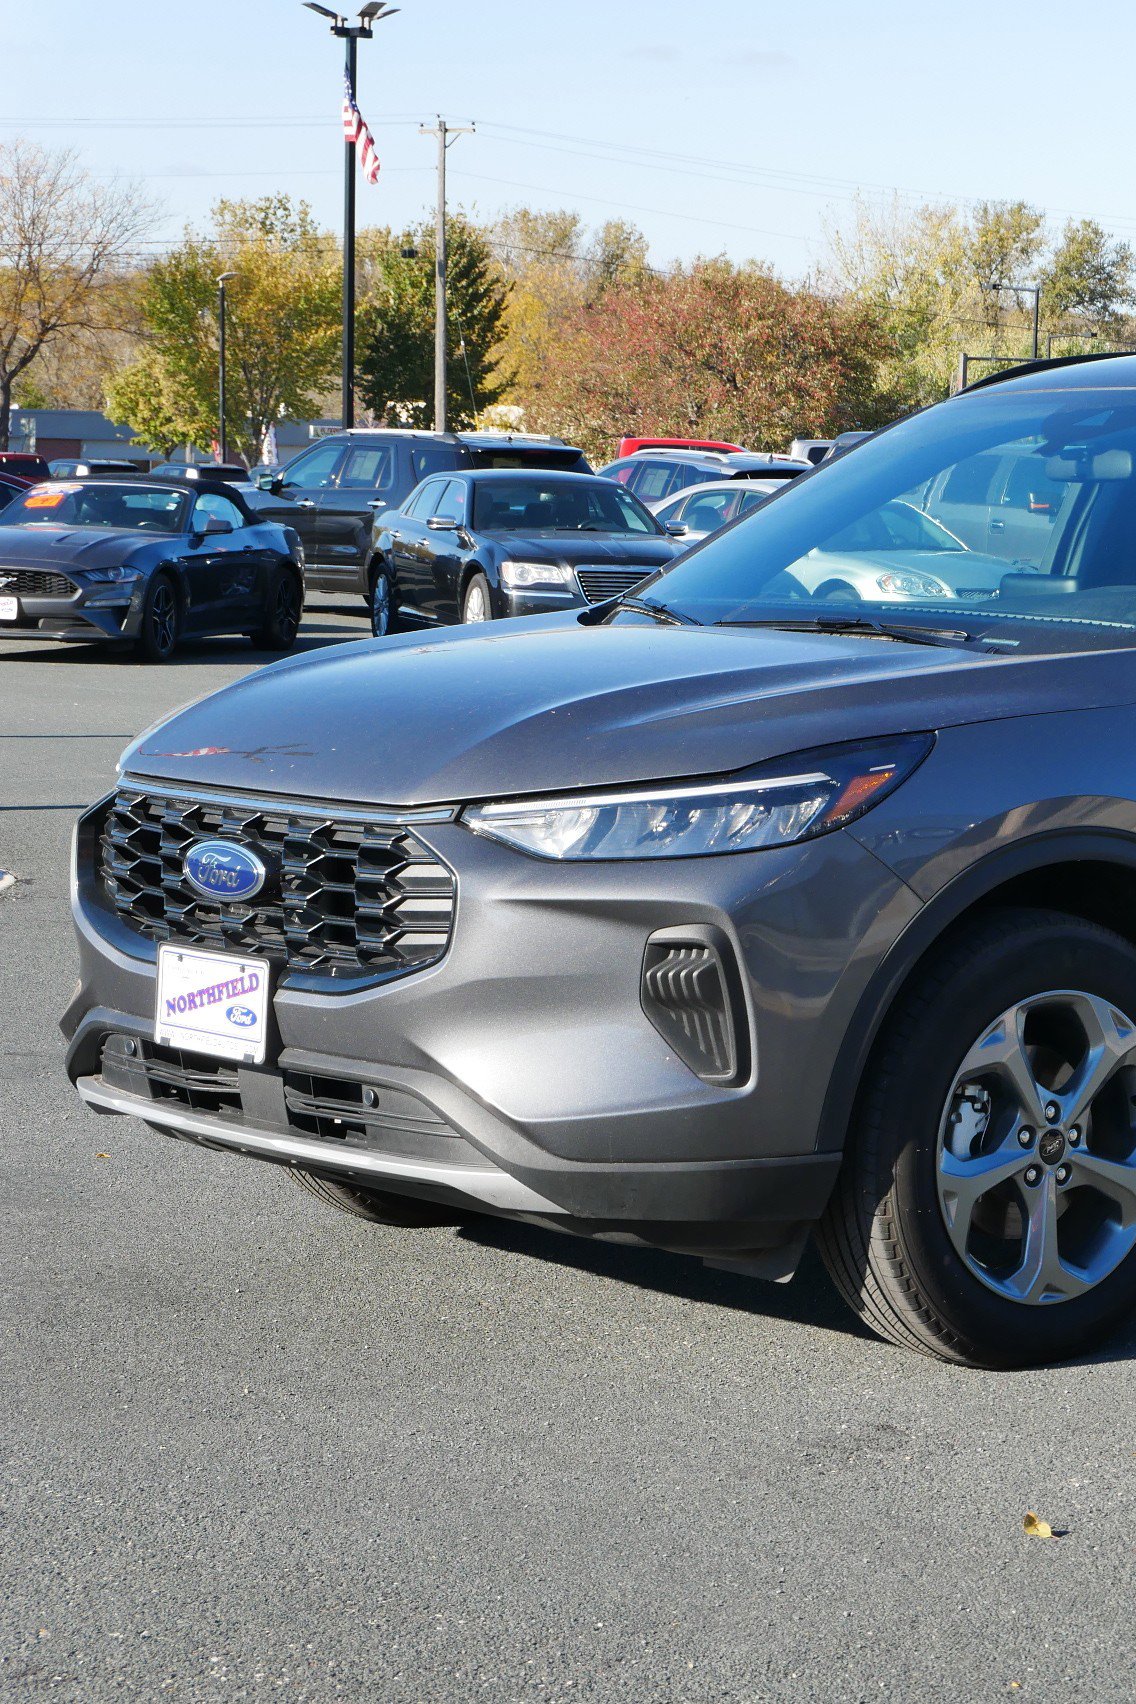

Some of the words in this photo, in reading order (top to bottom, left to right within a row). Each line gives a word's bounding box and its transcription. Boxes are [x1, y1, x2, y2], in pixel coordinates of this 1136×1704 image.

[198, 852, 241, 888] Ford
[165, 972, 260, 1018] NORTHFIELD
[230, 1006, 253, 1025] Ford
